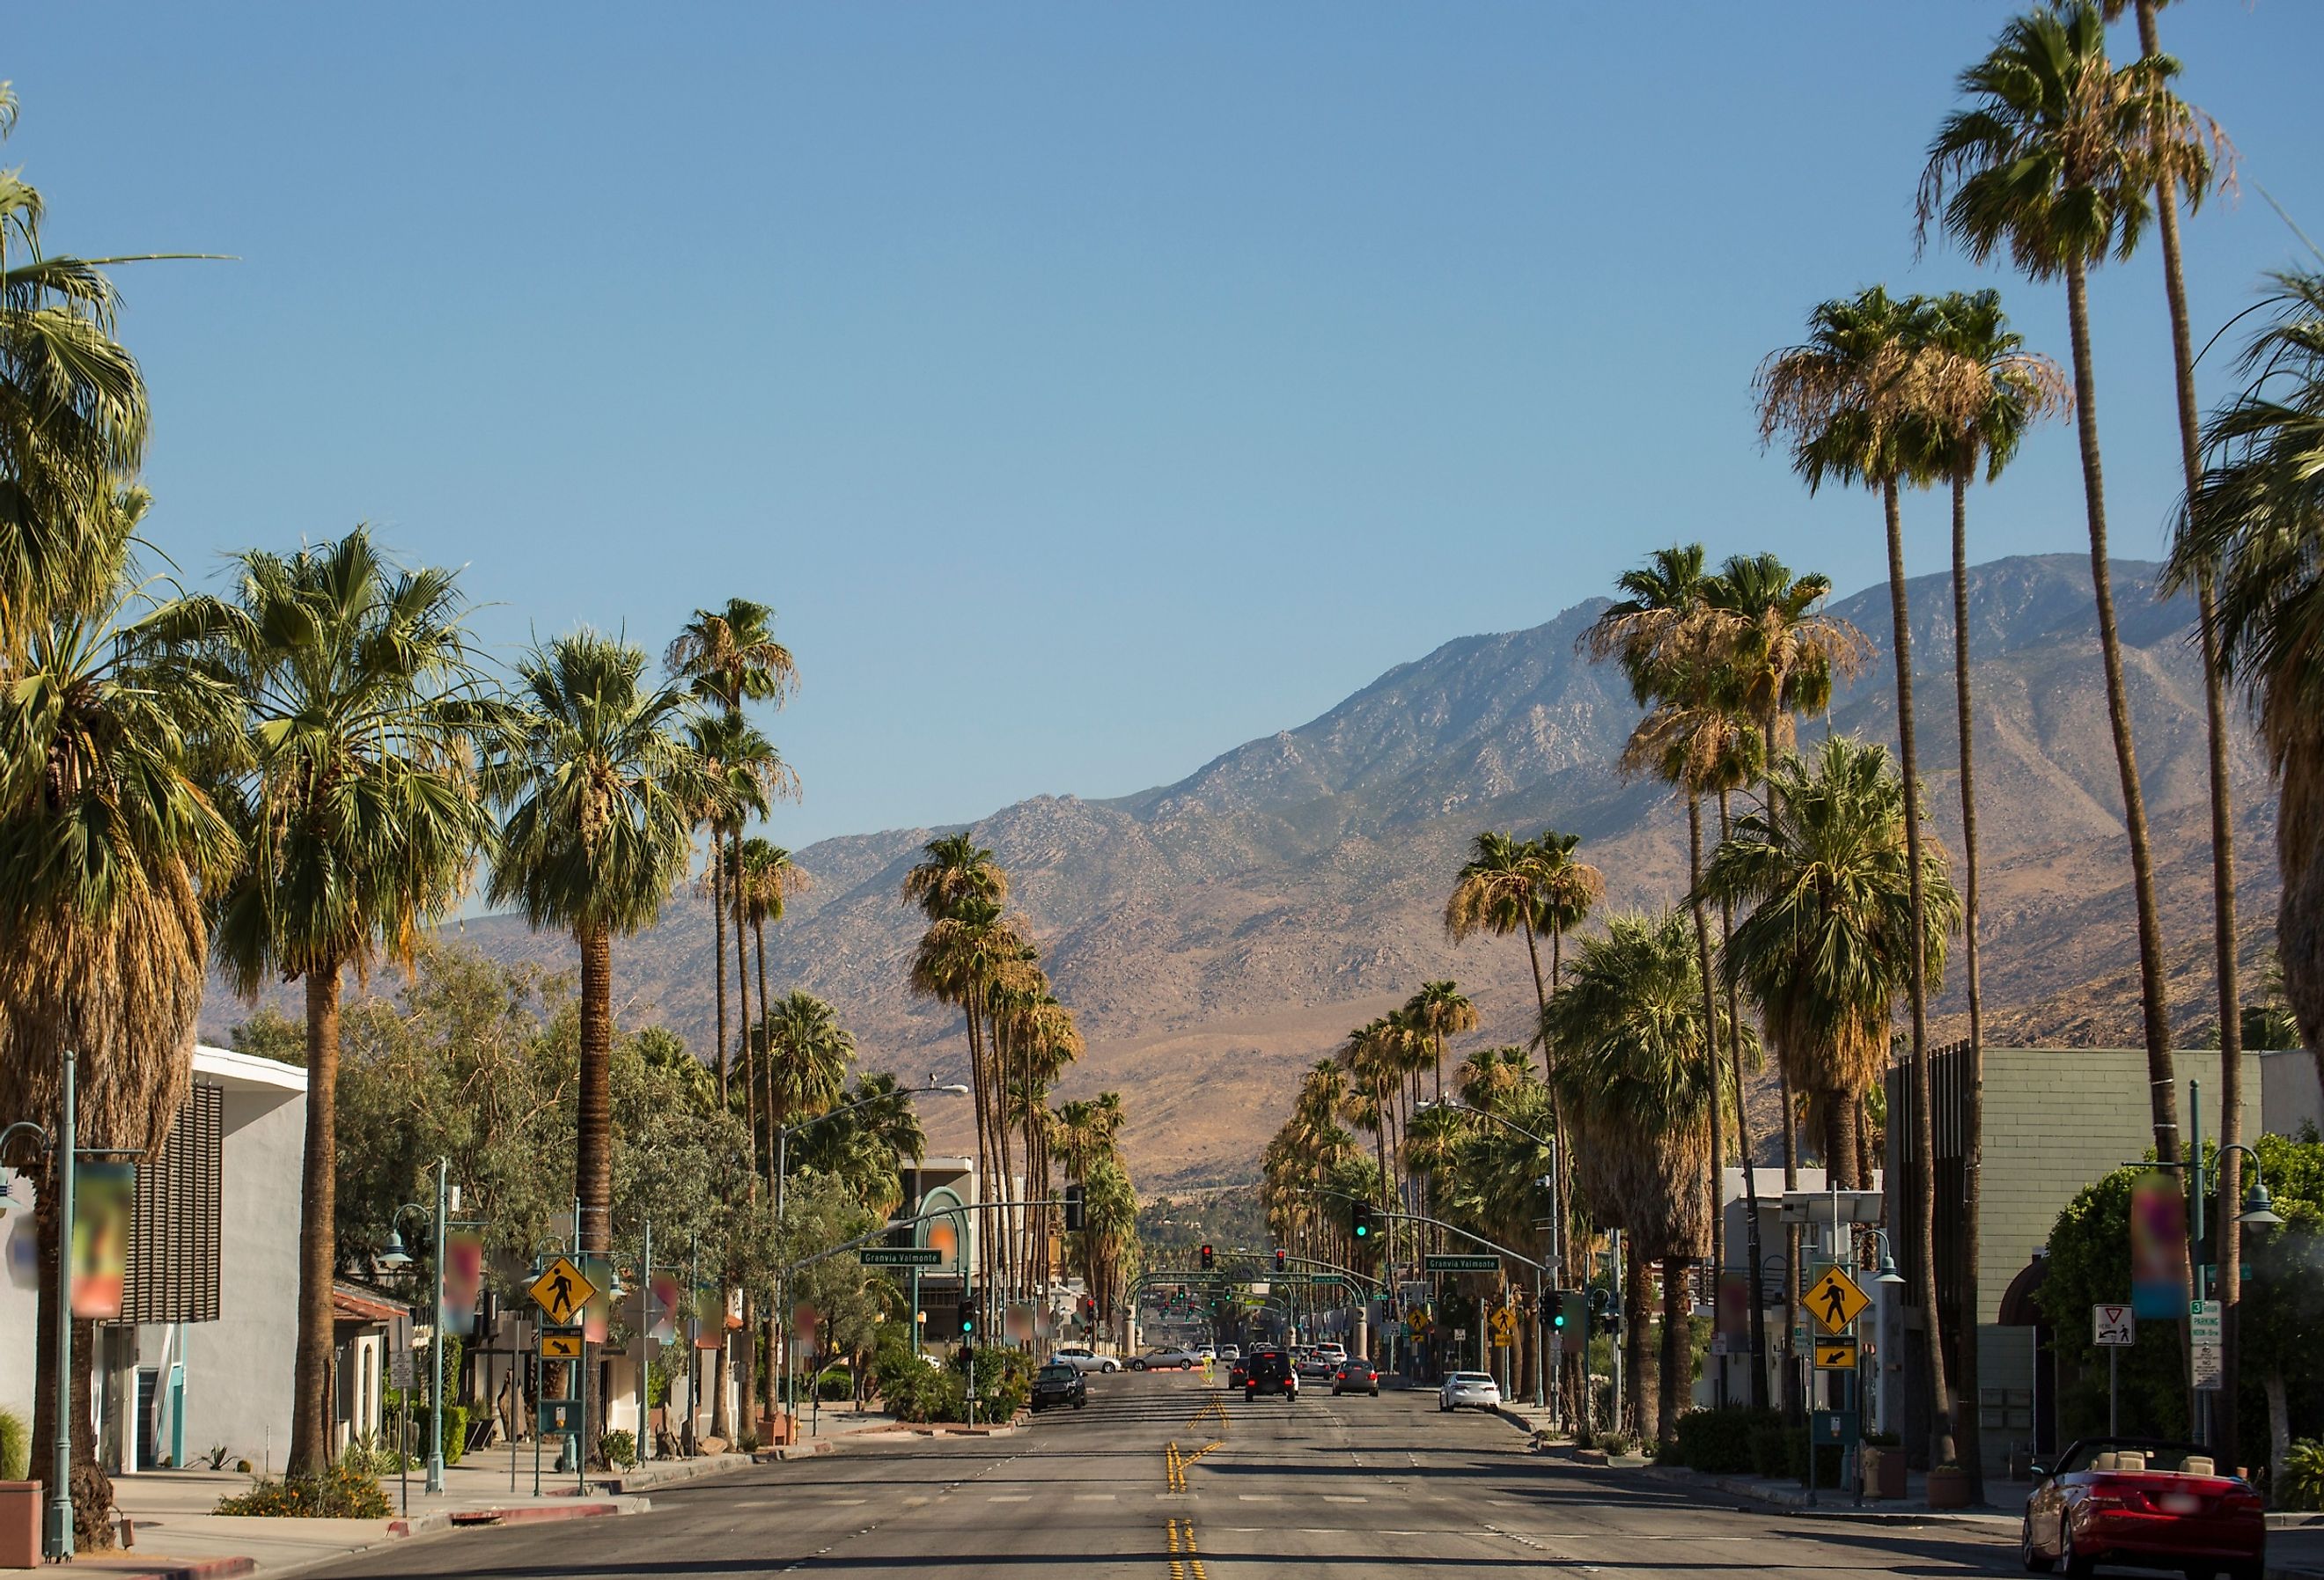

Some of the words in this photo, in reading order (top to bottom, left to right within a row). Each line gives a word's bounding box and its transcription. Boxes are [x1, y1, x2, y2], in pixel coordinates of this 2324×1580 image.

[865, 1253, 896, 1262] Granvia
[900, 1253, 938, 1262] Valmonte
[2194, 1303, 2201, 1312] 3
